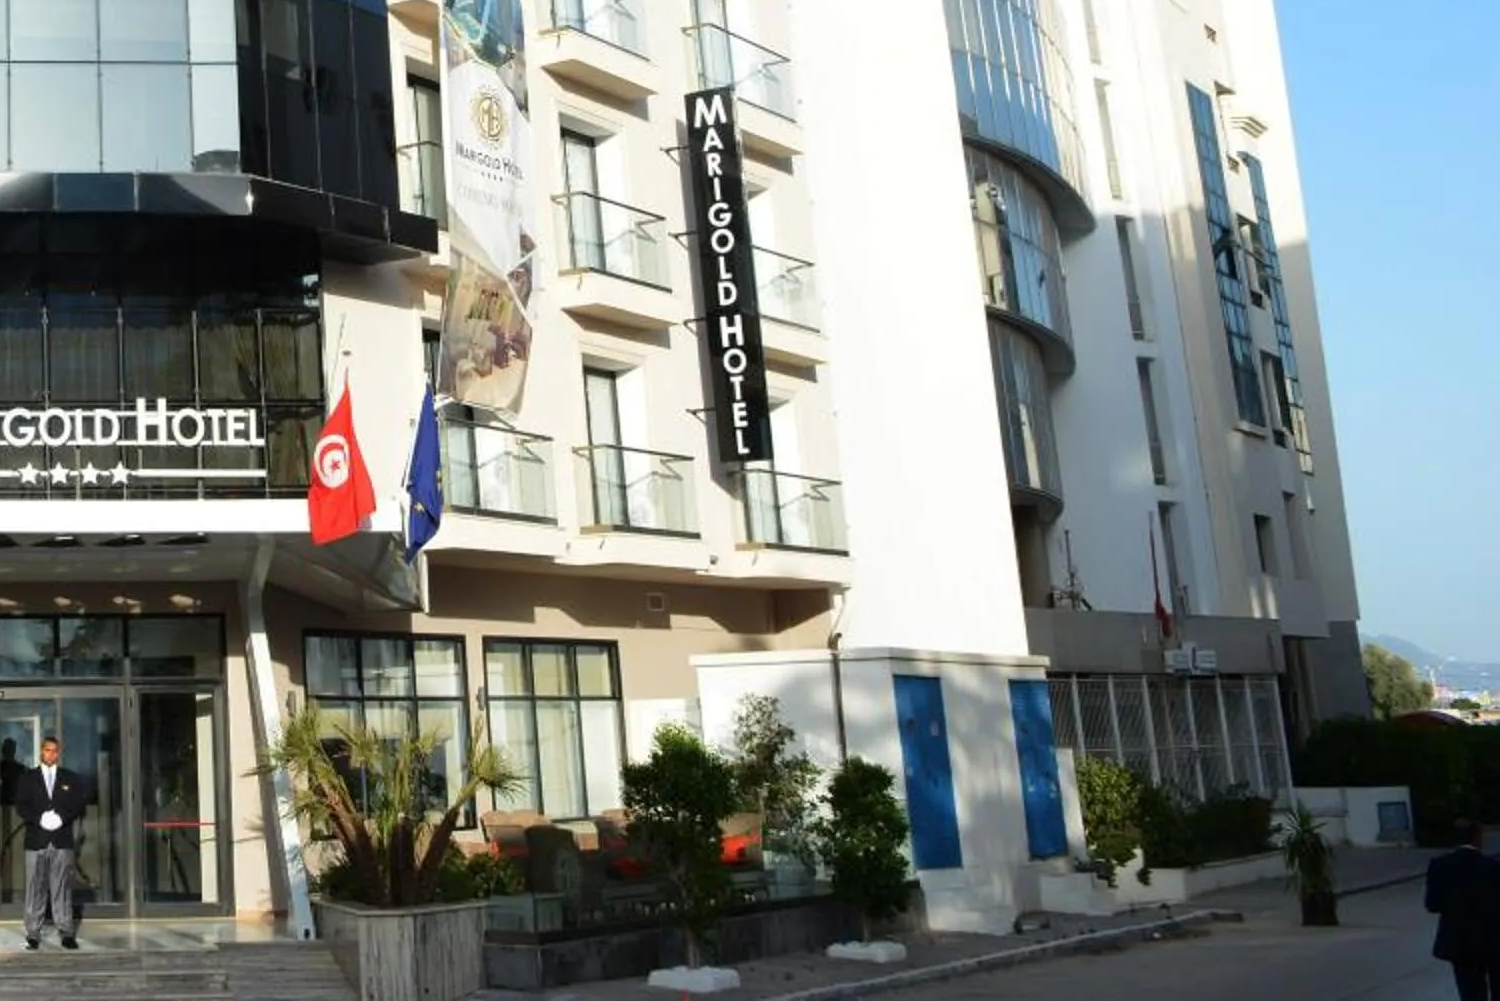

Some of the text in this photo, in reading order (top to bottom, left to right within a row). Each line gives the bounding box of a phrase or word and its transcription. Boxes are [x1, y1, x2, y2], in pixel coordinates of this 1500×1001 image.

[693, 95, 749, 455] MARIGOLD HOTEL
[137, 397, 265, 447] HOTEL
